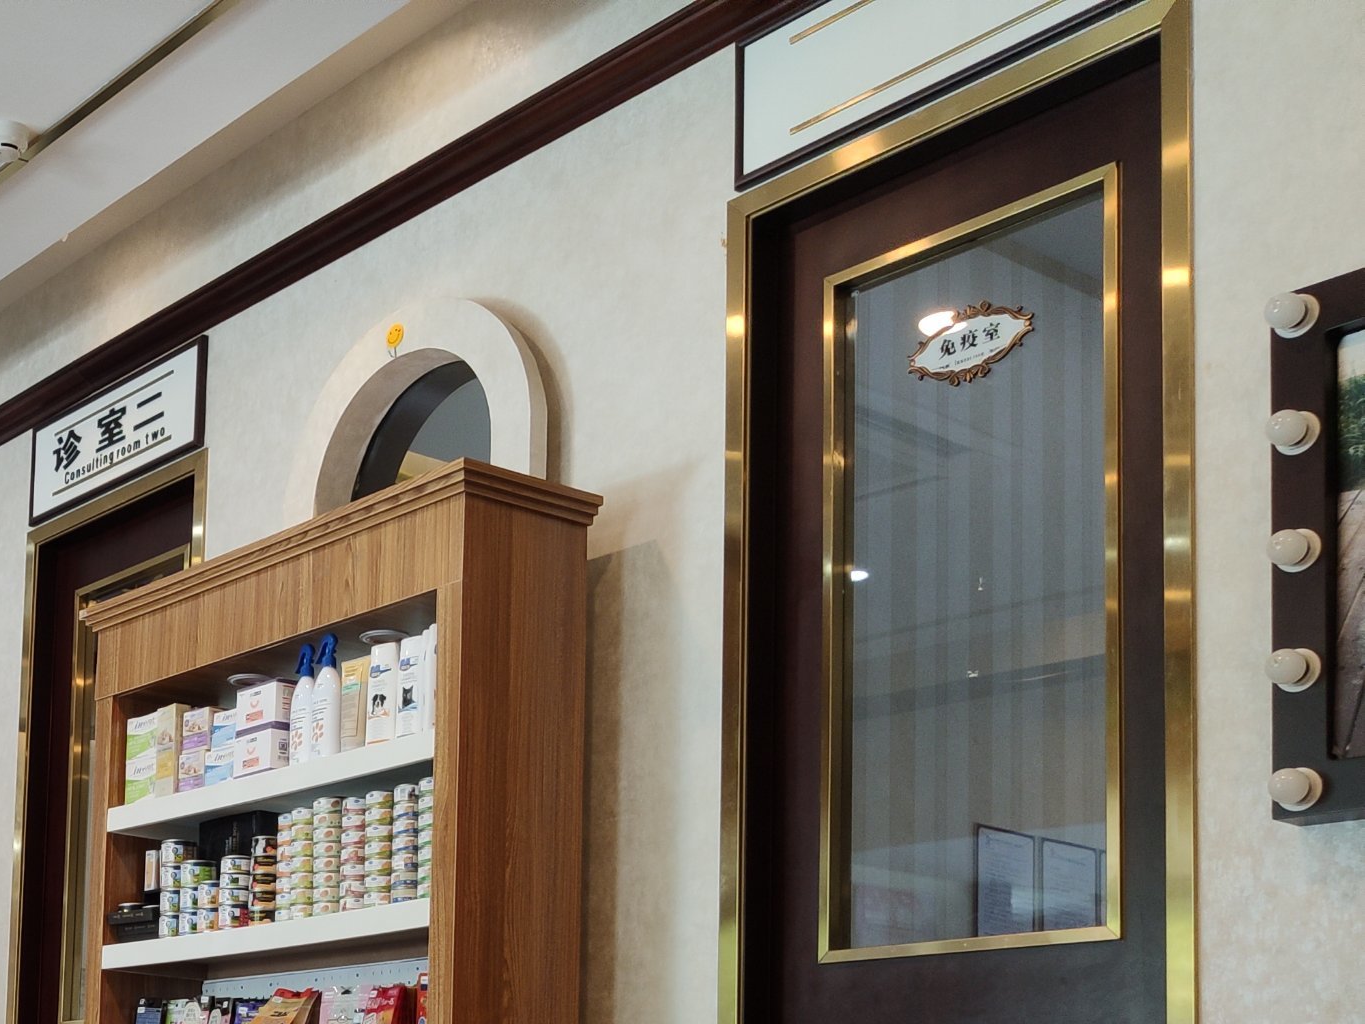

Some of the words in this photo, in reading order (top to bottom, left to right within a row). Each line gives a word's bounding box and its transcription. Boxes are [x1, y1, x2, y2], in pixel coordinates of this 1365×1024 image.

[939, 322, 1001, 360] 免疫室
[53, 391, 164, 472] 诊室二
[64, 451, 114, 485] Consulting
[116, 439, 141, 461] room
[145, 427, 165, 445] two
